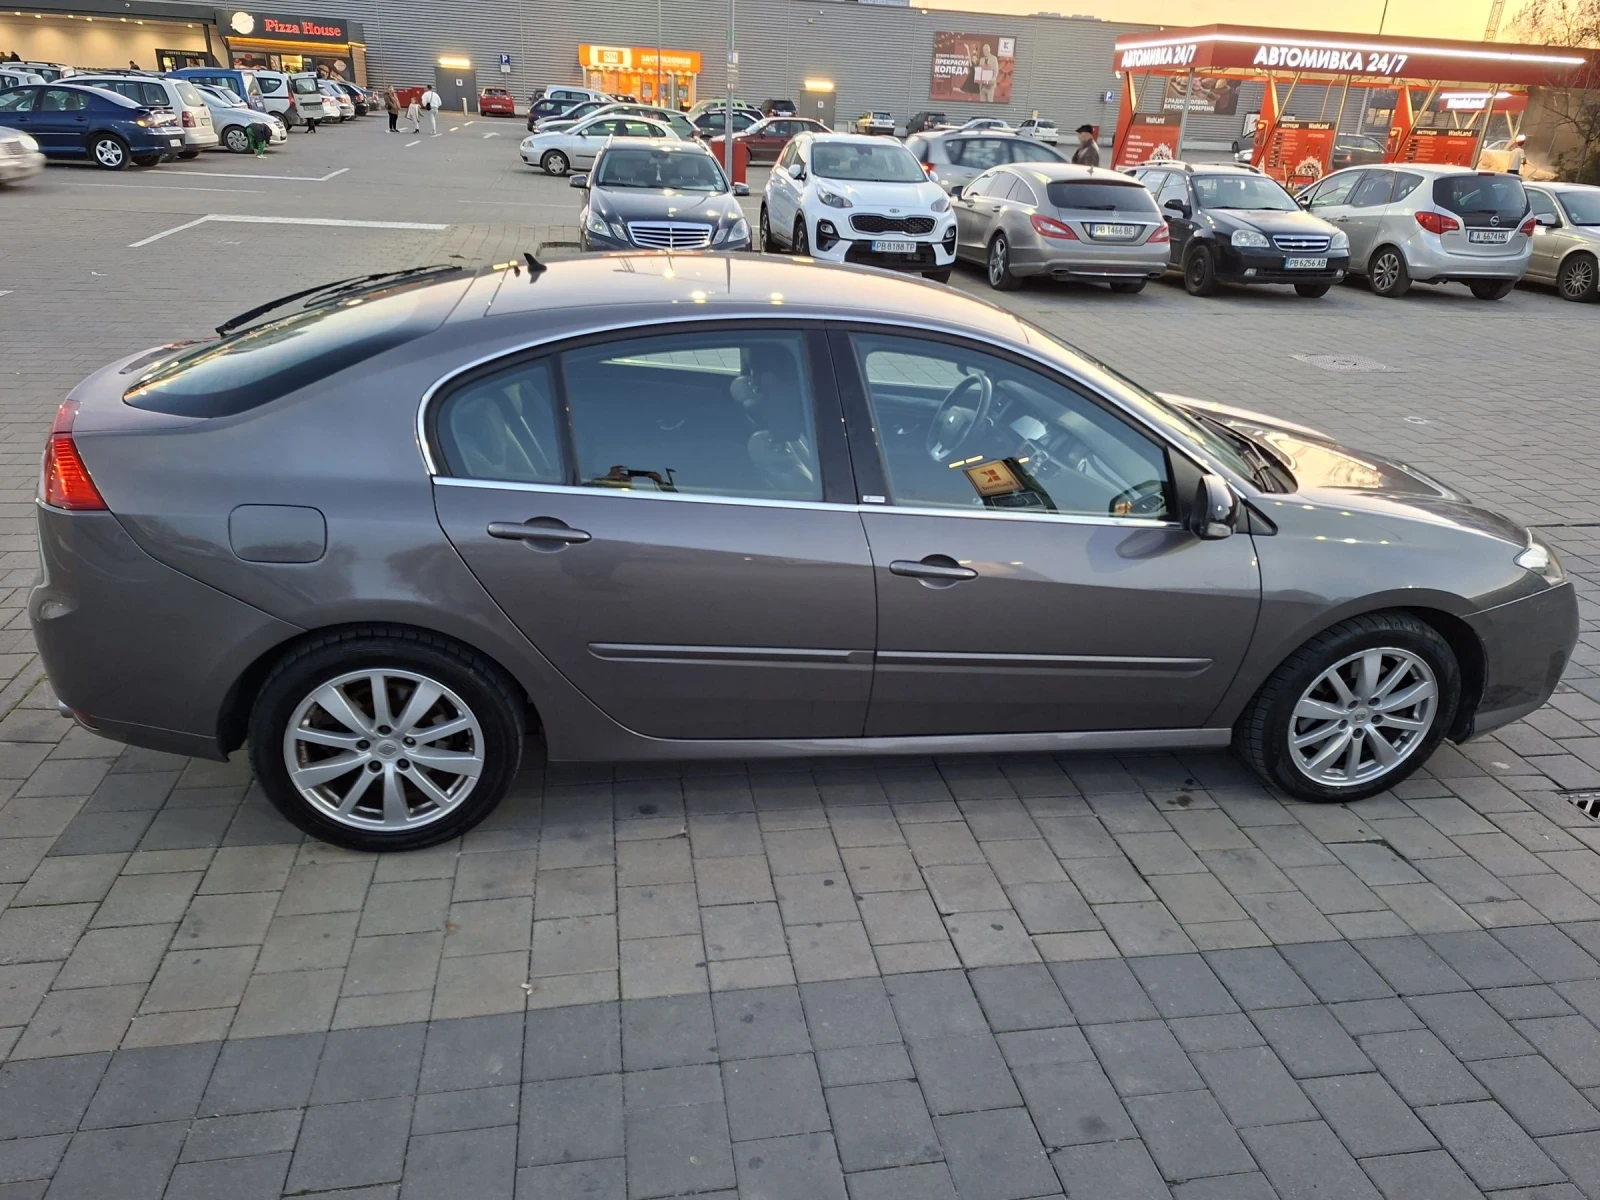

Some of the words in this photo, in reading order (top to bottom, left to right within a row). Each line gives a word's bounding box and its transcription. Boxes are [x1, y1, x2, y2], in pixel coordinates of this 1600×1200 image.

[265, 19, 300, 33] Pizza
[302, 22, 341, 36] House
[935, 58, 969, 66] ПРЕКРАСНА
[1121, 47, 1172, 68] АВТОМИВКА
[1173, 44, 1197, 66] 24/7
[1253, 45, 1363, 71] АВТОМИВКА
[1366, 53, 1408, 75] 24/7
[934, 65, 969, 76] КОЛЕДА
[1309, 122, 1330, 130] WashLand
